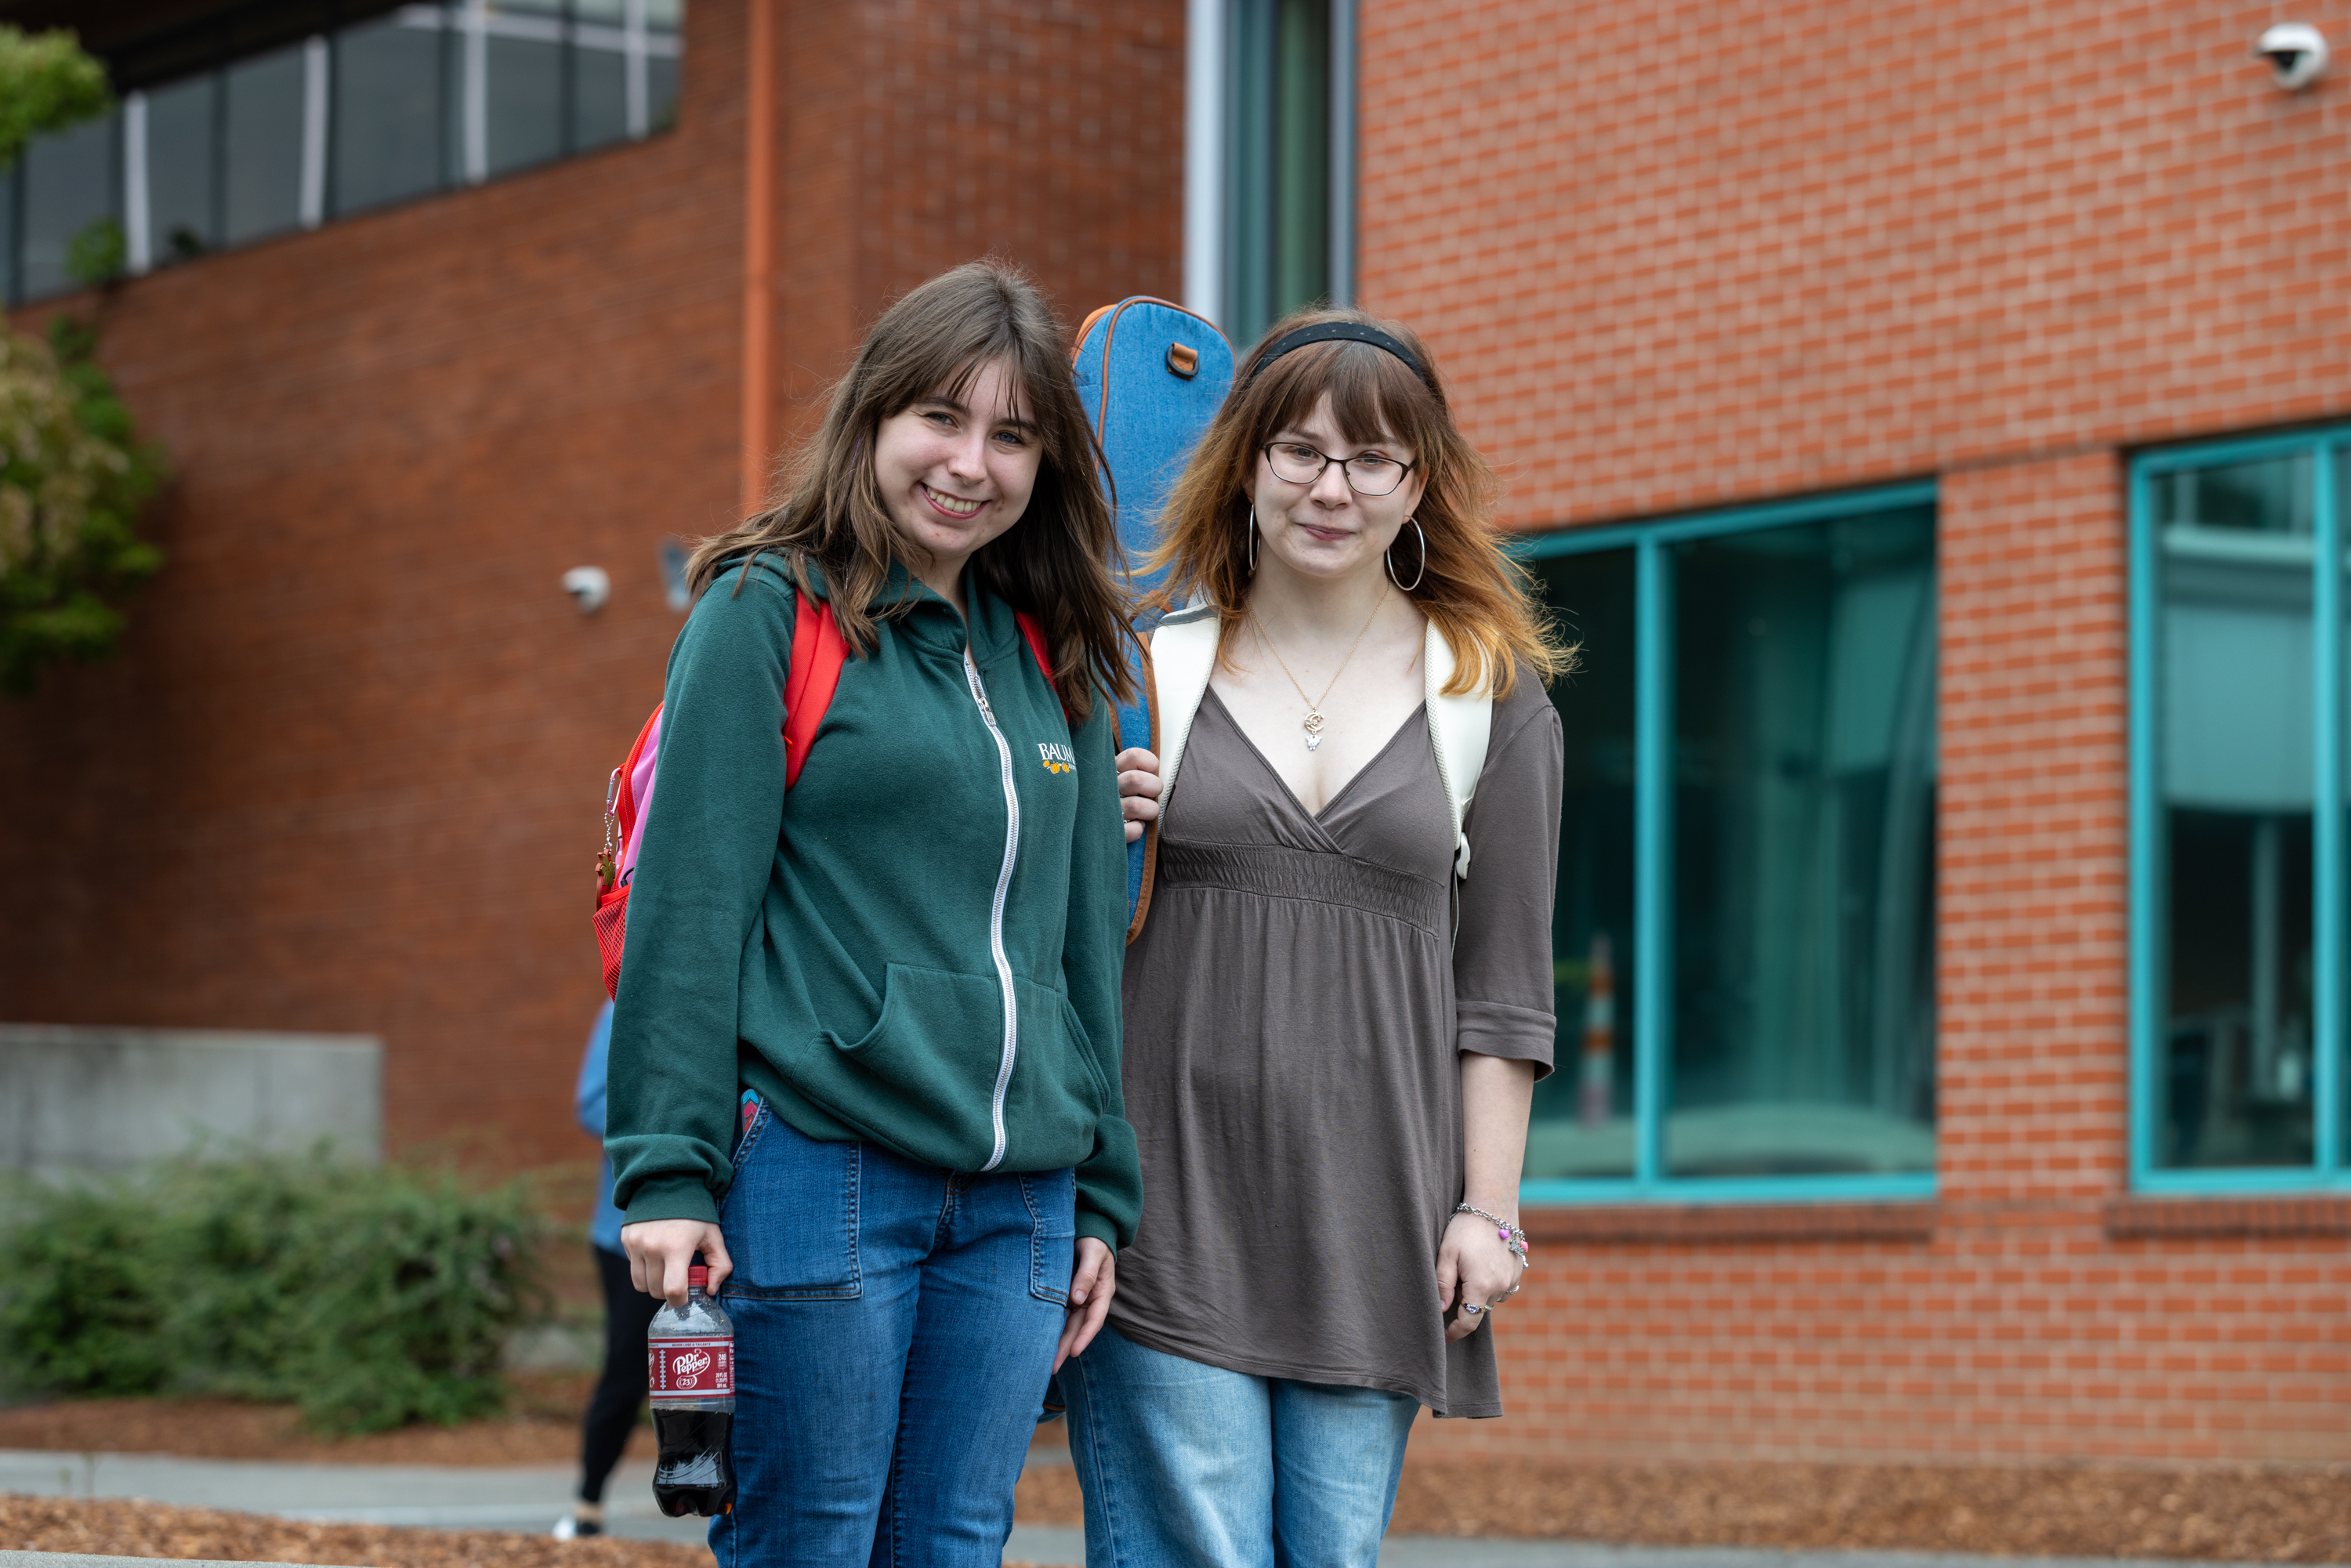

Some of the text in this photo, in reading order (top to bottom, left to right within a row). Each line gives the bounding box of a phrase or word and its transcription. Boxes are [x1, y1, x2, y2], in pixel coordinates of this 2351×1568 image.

[1037, 743, 1076, 765] BAUM
[676, 1356, 708, 1374] Pepper
[686, 1353, 699, 1363] Dr
